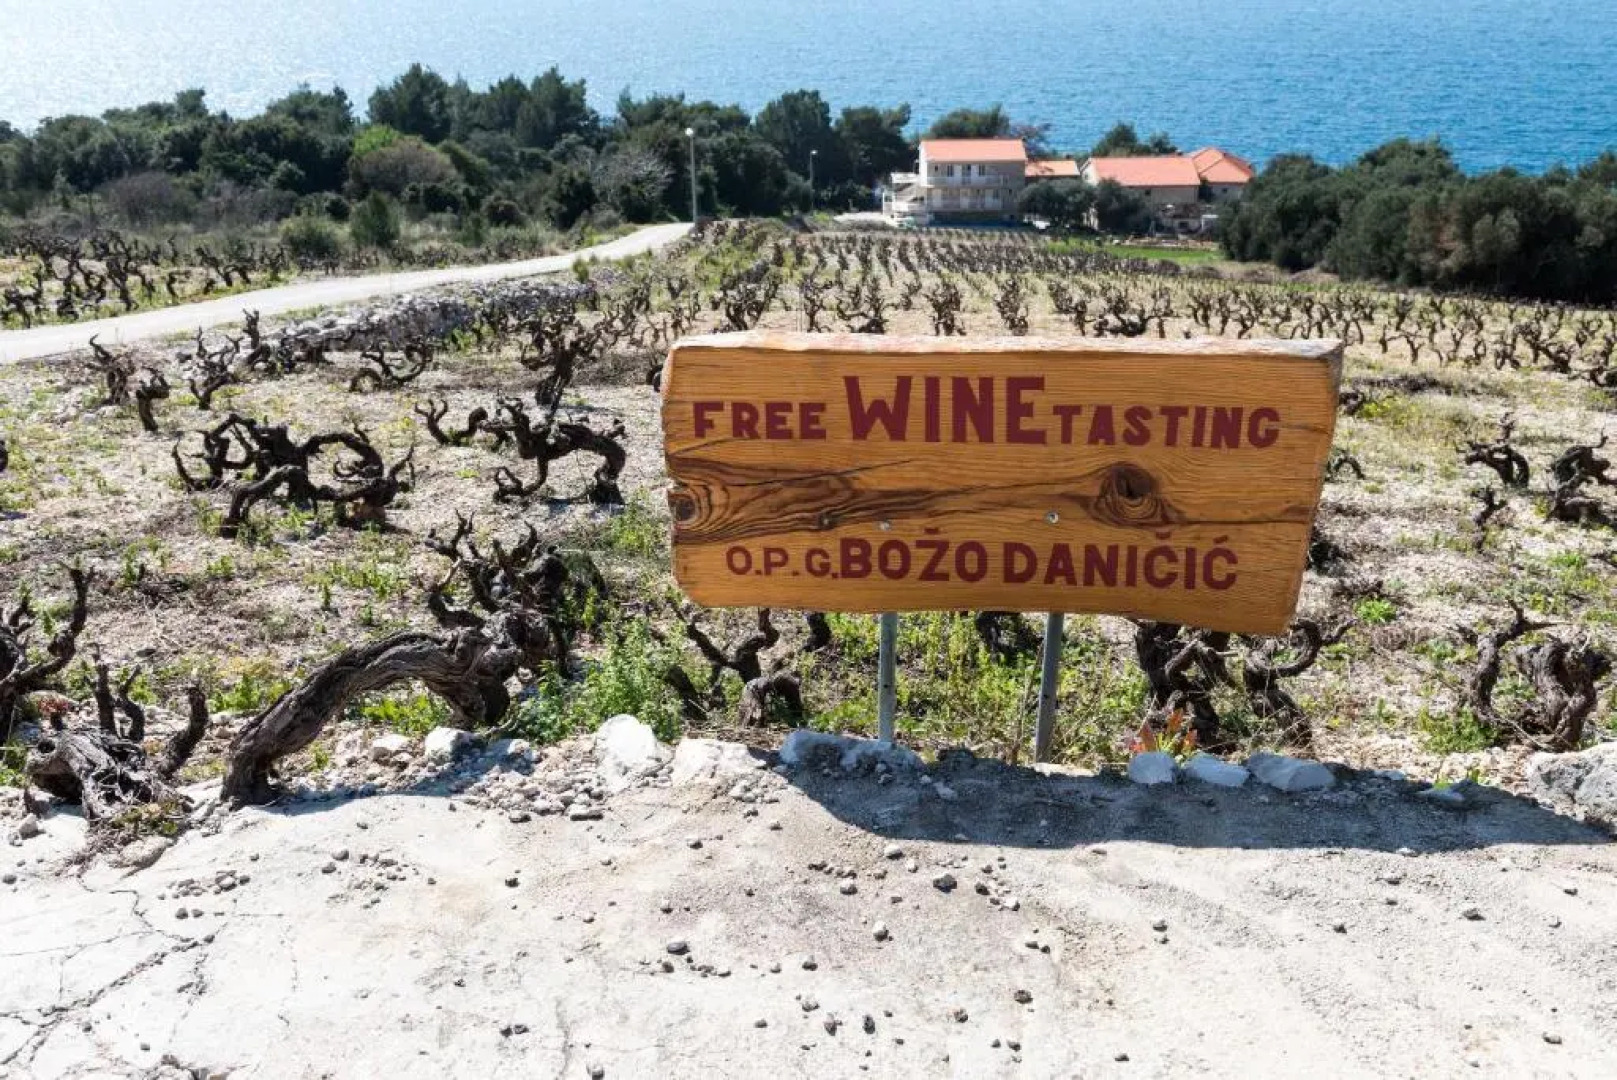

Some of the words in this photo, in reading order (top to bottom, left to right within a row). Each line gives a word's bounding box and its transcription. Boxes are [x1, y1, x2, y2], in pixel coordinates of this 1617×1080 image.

[693, 402, 827, 440] FREE
[844, 376, 1047, 444] WINE
[1053, 405, 1280, 448] TASTING
[839, 527, 988, 583] BOŽO
[1002, 531, 1239, 590] DANIČIĆ
